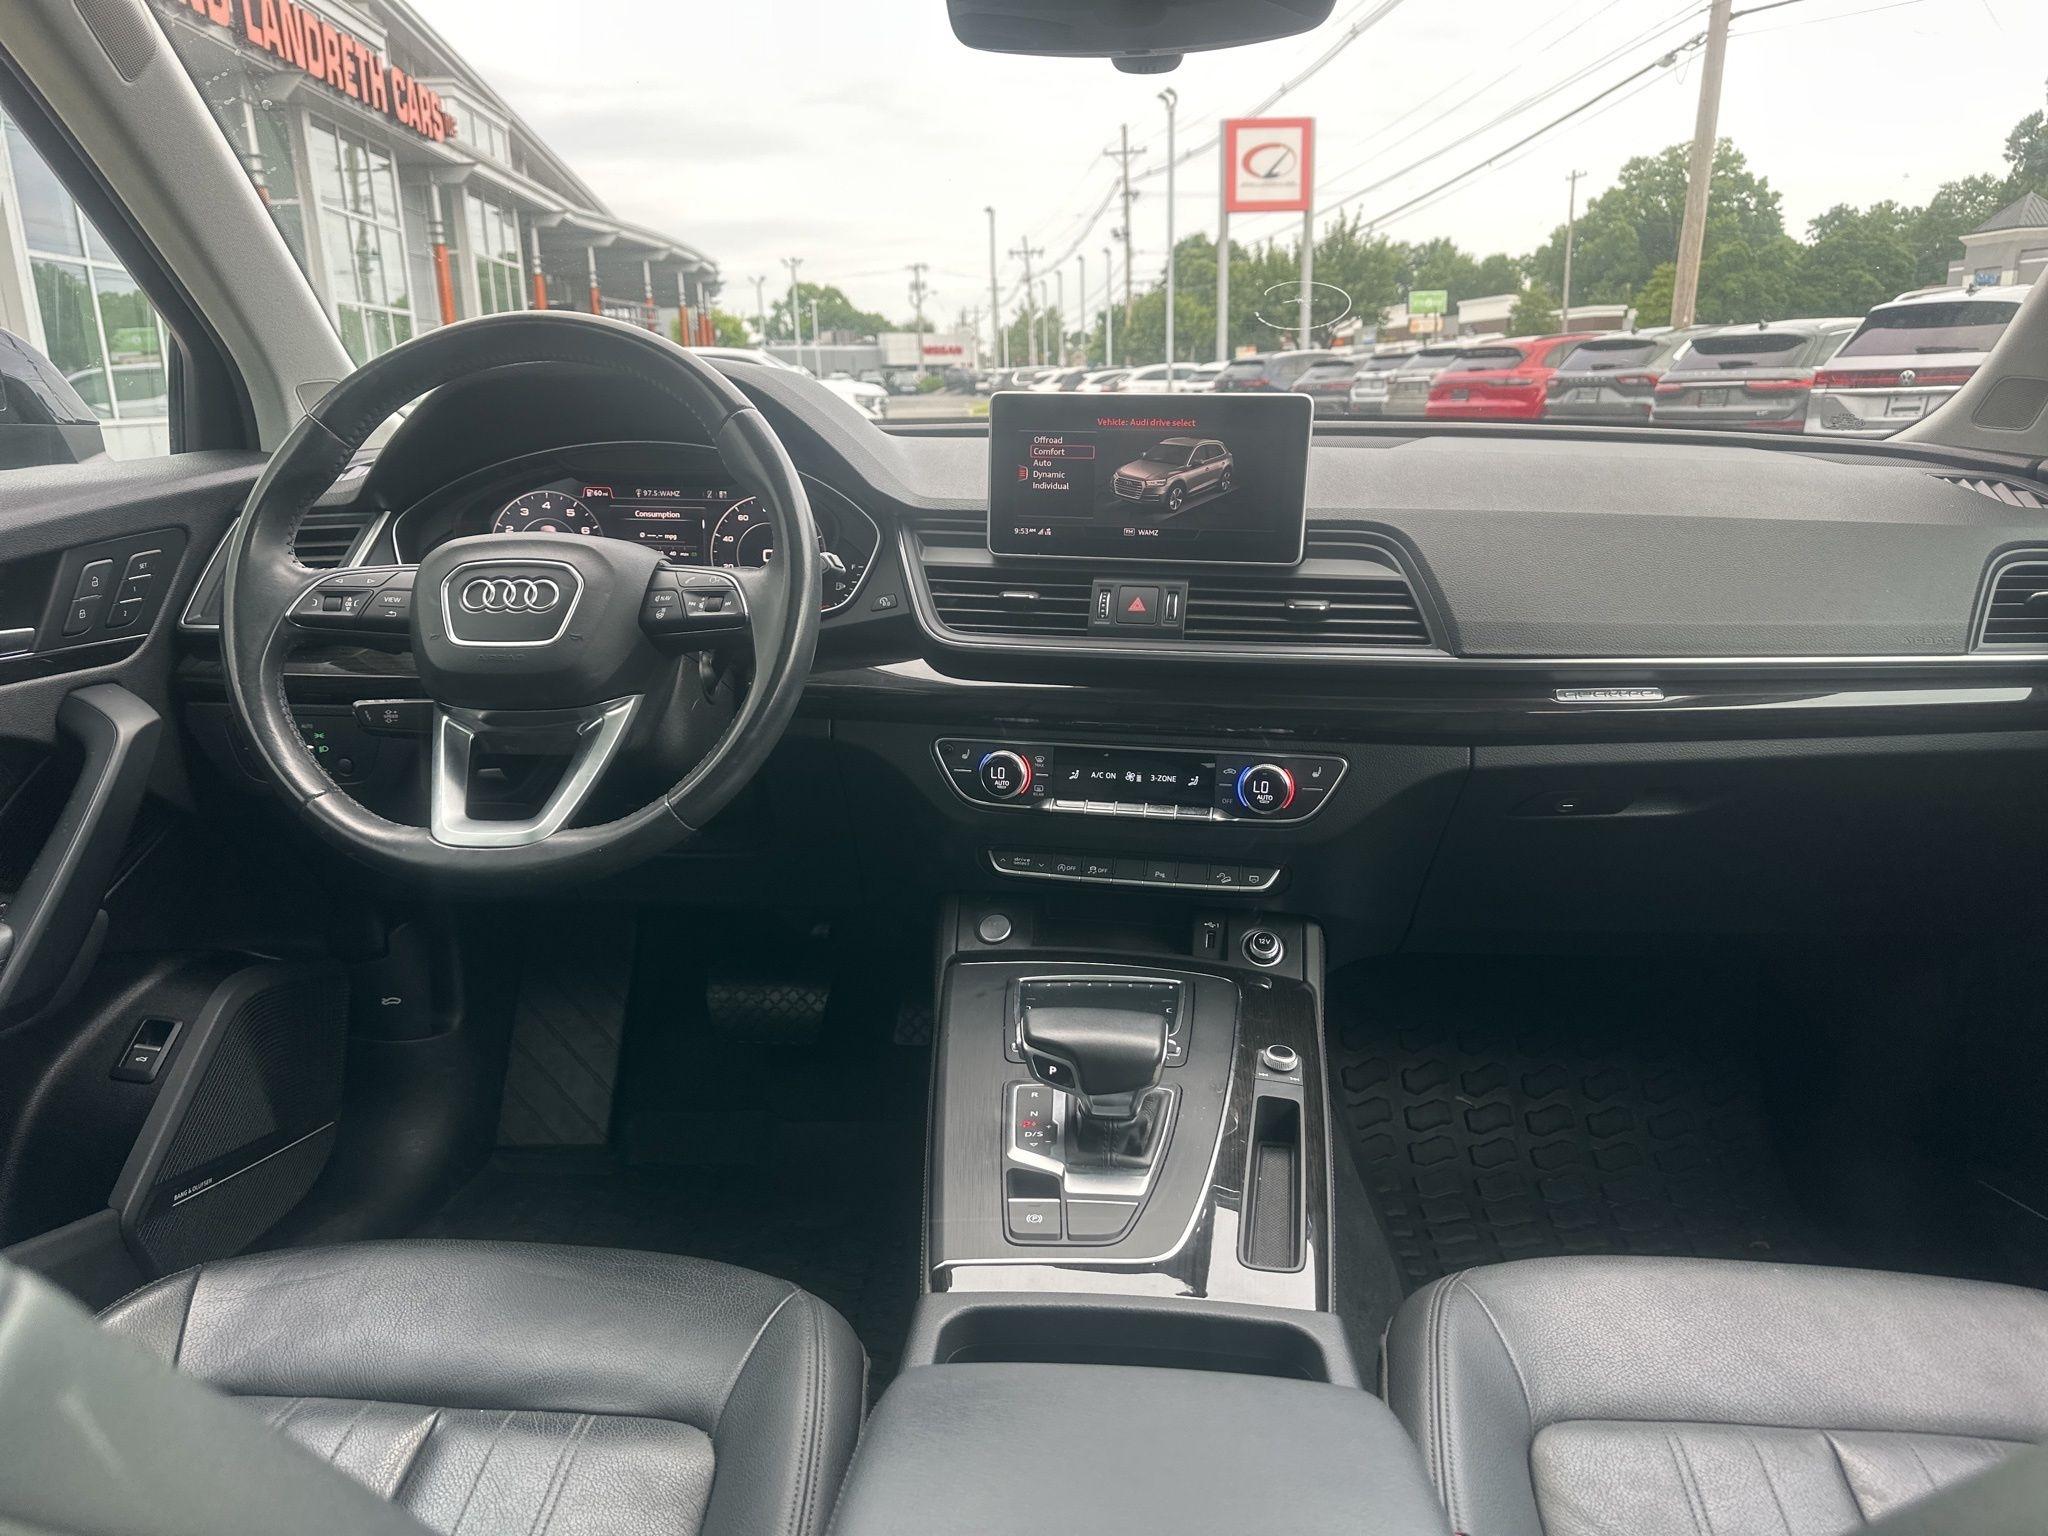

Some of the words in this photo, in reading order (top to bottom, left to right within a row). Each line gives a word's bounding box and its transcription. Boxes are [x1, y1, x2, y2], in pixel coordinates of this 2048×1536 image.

[242, 0, 389, 115] LANDRETH
[391, 65, 448, 145] CARS
[1097, 418, 1128, 426] Vehicle:
[1130, 418, 1149, 426] Audi
[1150, 418, 1170, 427] drive
[1172, 419, 1197, 427] select
[1033, 436, 1063, 444] Offroad
[1033, 447, 1065, 456] Comfort
[1033, 459, 1052, 467] Auto
[1032, 470, 1066, 479] Dynamic
[1032, 482, 1069, 490] Individual
[593, 488, 602, 497] 60
[541, 501, 551, 510] 4
[520, 507, 530, 516] 3
[566, 508, 576, 517] 5
[634, 510, 681, 520] Consumption
[737, 514, 749, 522] 60
[580, 526, 590, 535] 6
[664, 533, 678, 541] mpg
[723, 535, 734, 543] 40
[990, 766, 1006, 780] LO
[1091, 771, 1104, 779] A/C
[1105, 772, 1117, 780] ON
[1150, 774, 1177, 783] 3-ZONE
[1252, 780, 1269, 794] LO
[1049, 1065, 1057, 1075] P
